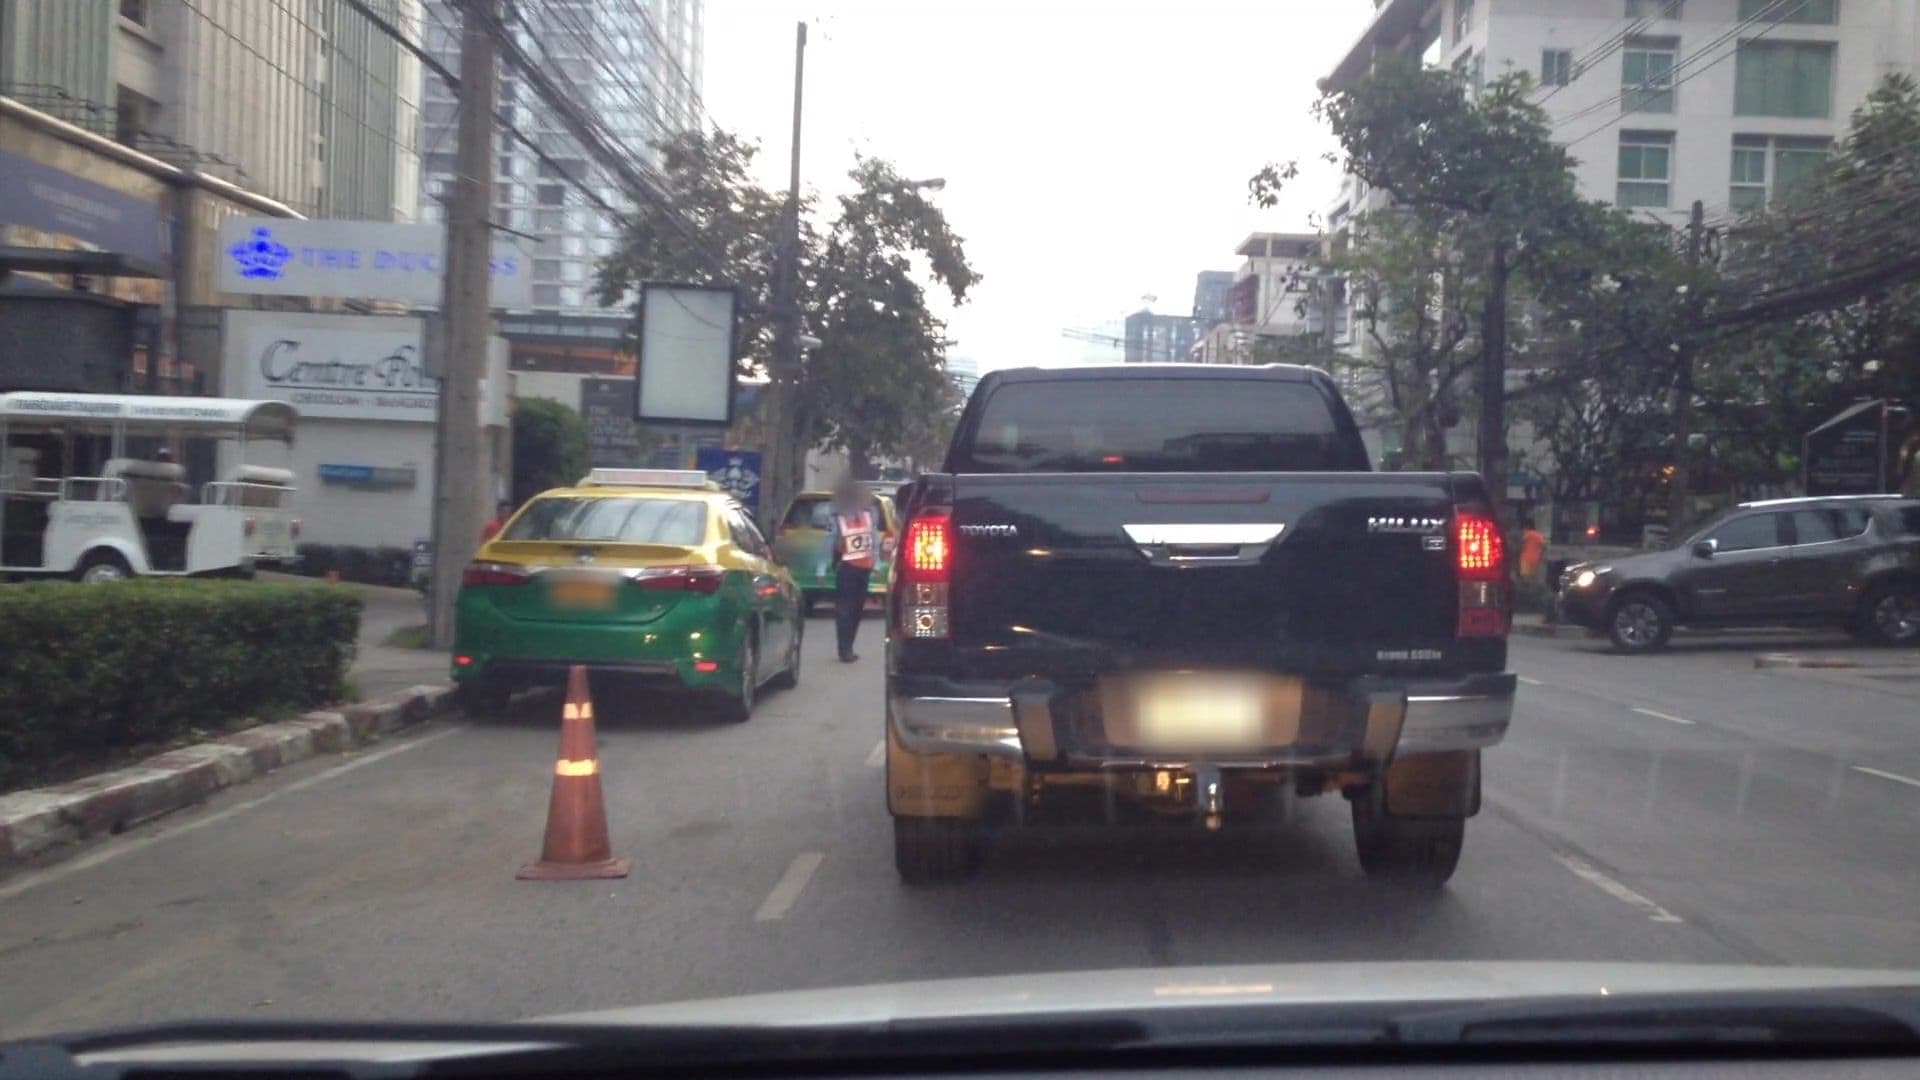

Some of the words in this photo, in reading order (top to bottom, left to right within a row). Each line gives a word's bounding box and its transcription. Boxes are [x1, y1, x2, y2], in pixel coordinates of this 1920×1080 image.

[303, 248, 360, 270] THE
[374, 251, 518, 277] DUCSS
[959, 524, 1019, 537] TOYOTA
